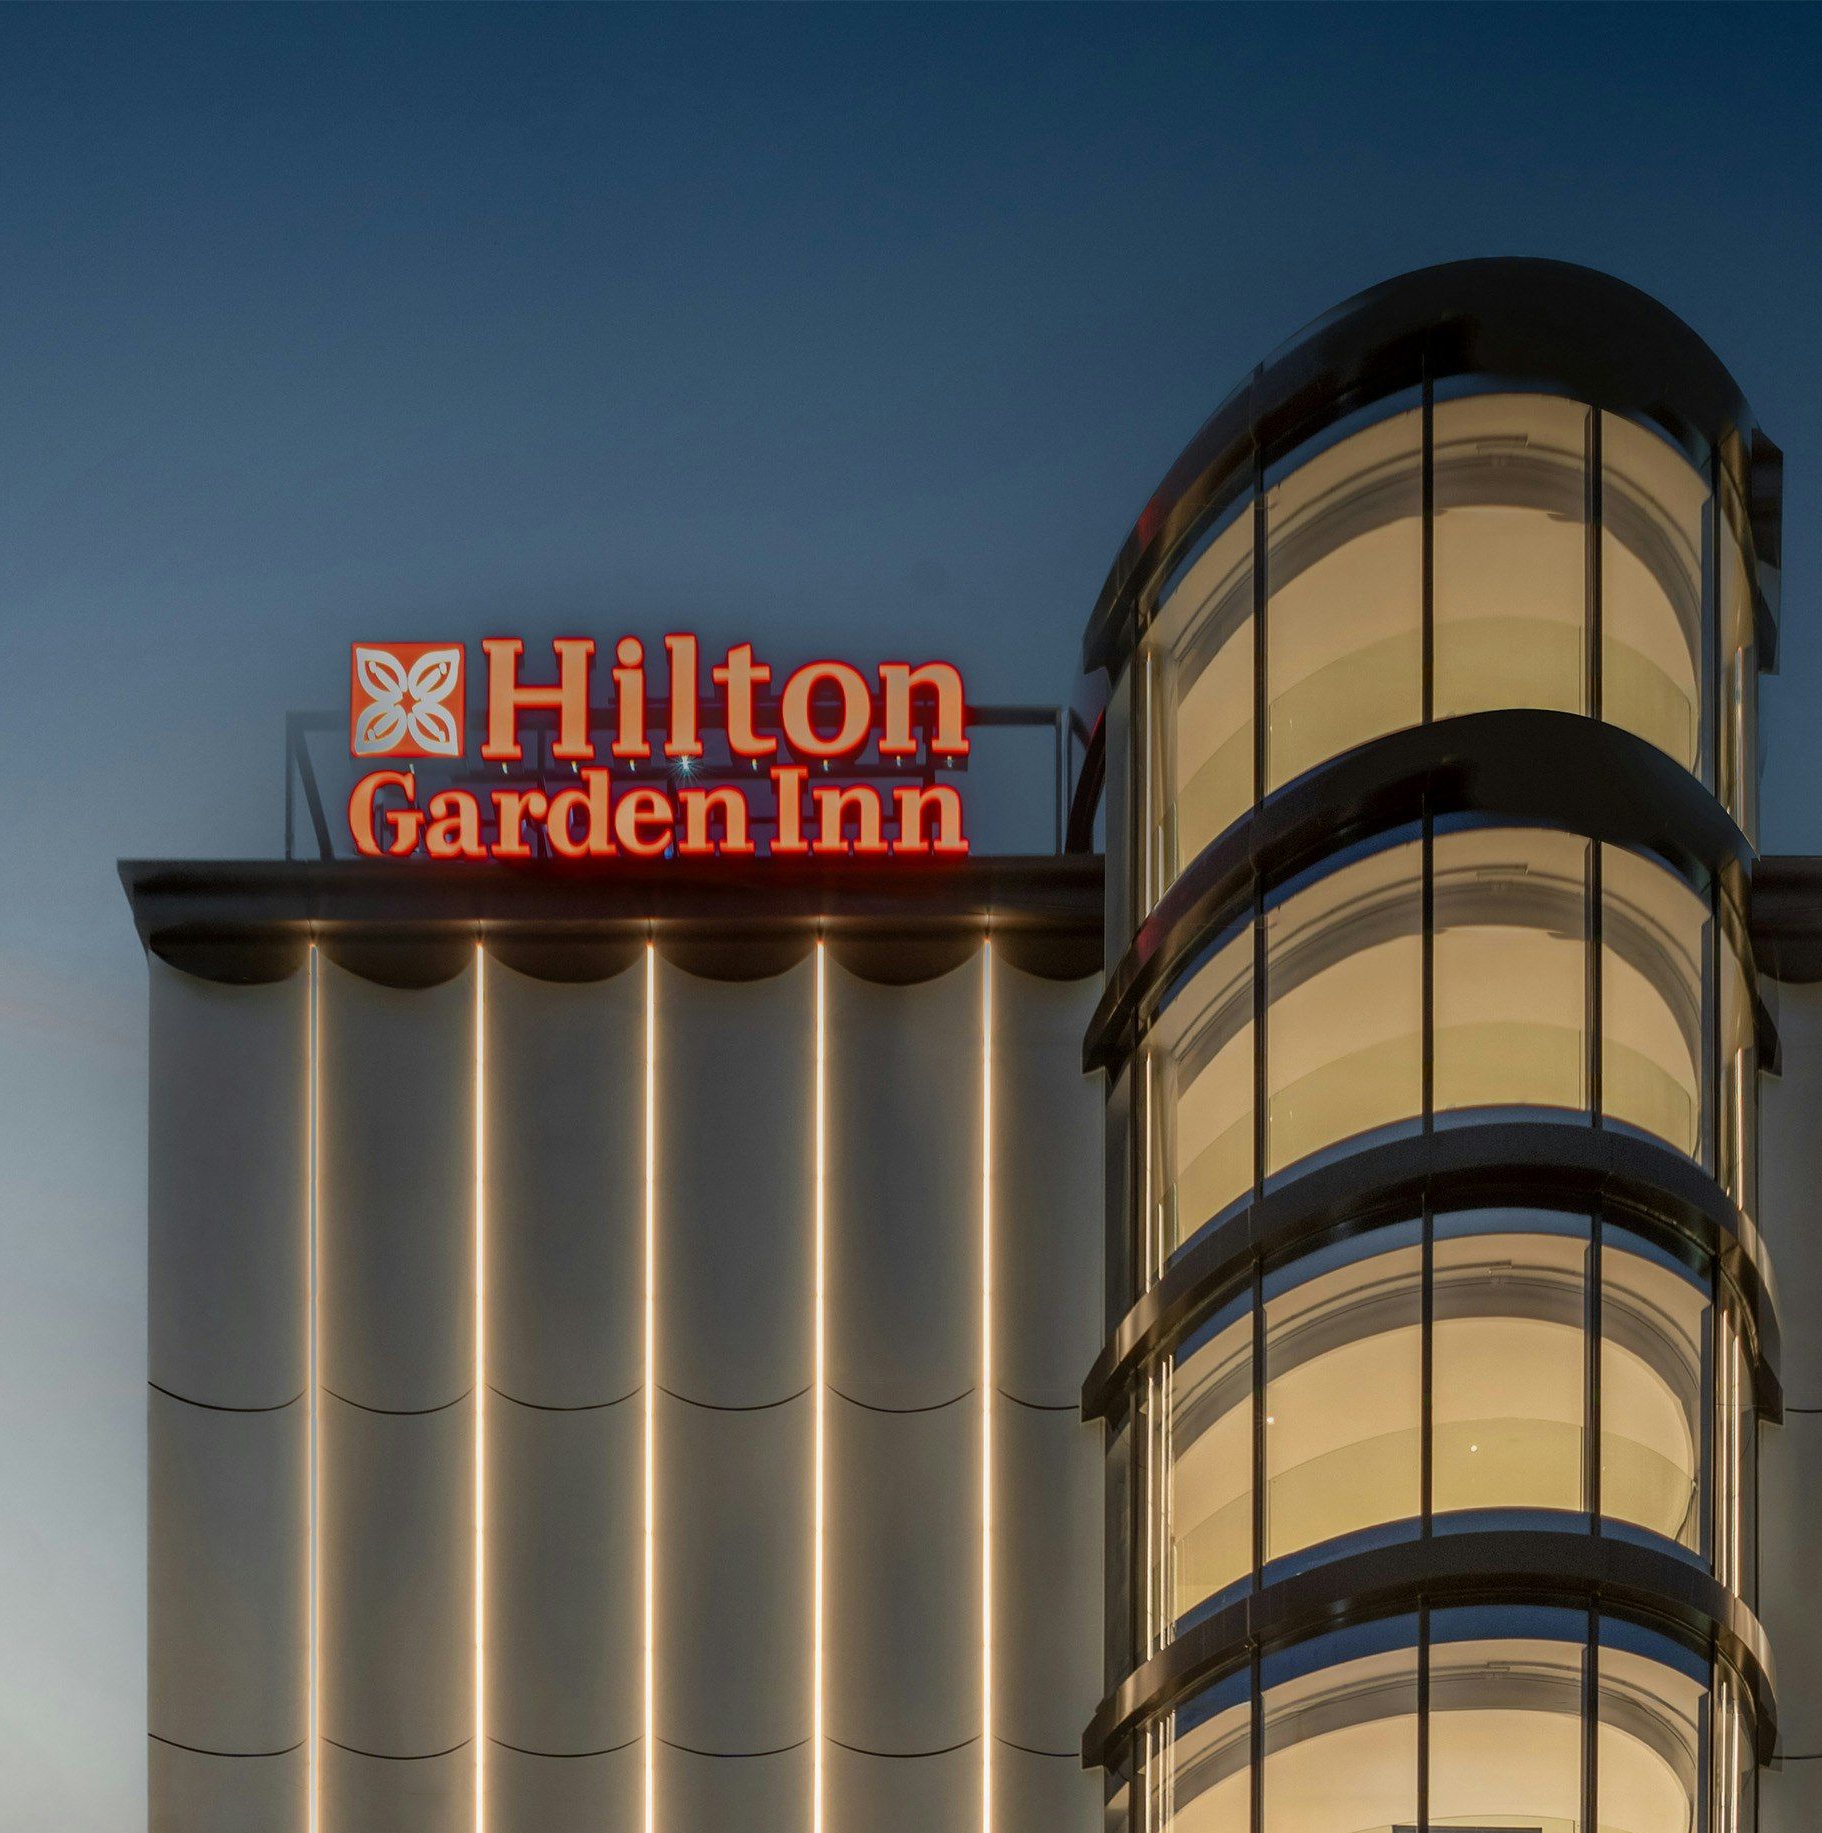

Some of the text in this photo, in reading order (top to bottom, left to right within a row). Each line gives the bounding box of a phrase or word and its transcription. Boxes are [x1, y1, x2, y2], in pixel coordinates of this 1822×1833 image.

[480, 633, 971, 762] Hilton
[348, 766, 970, 861] Garden Inn
